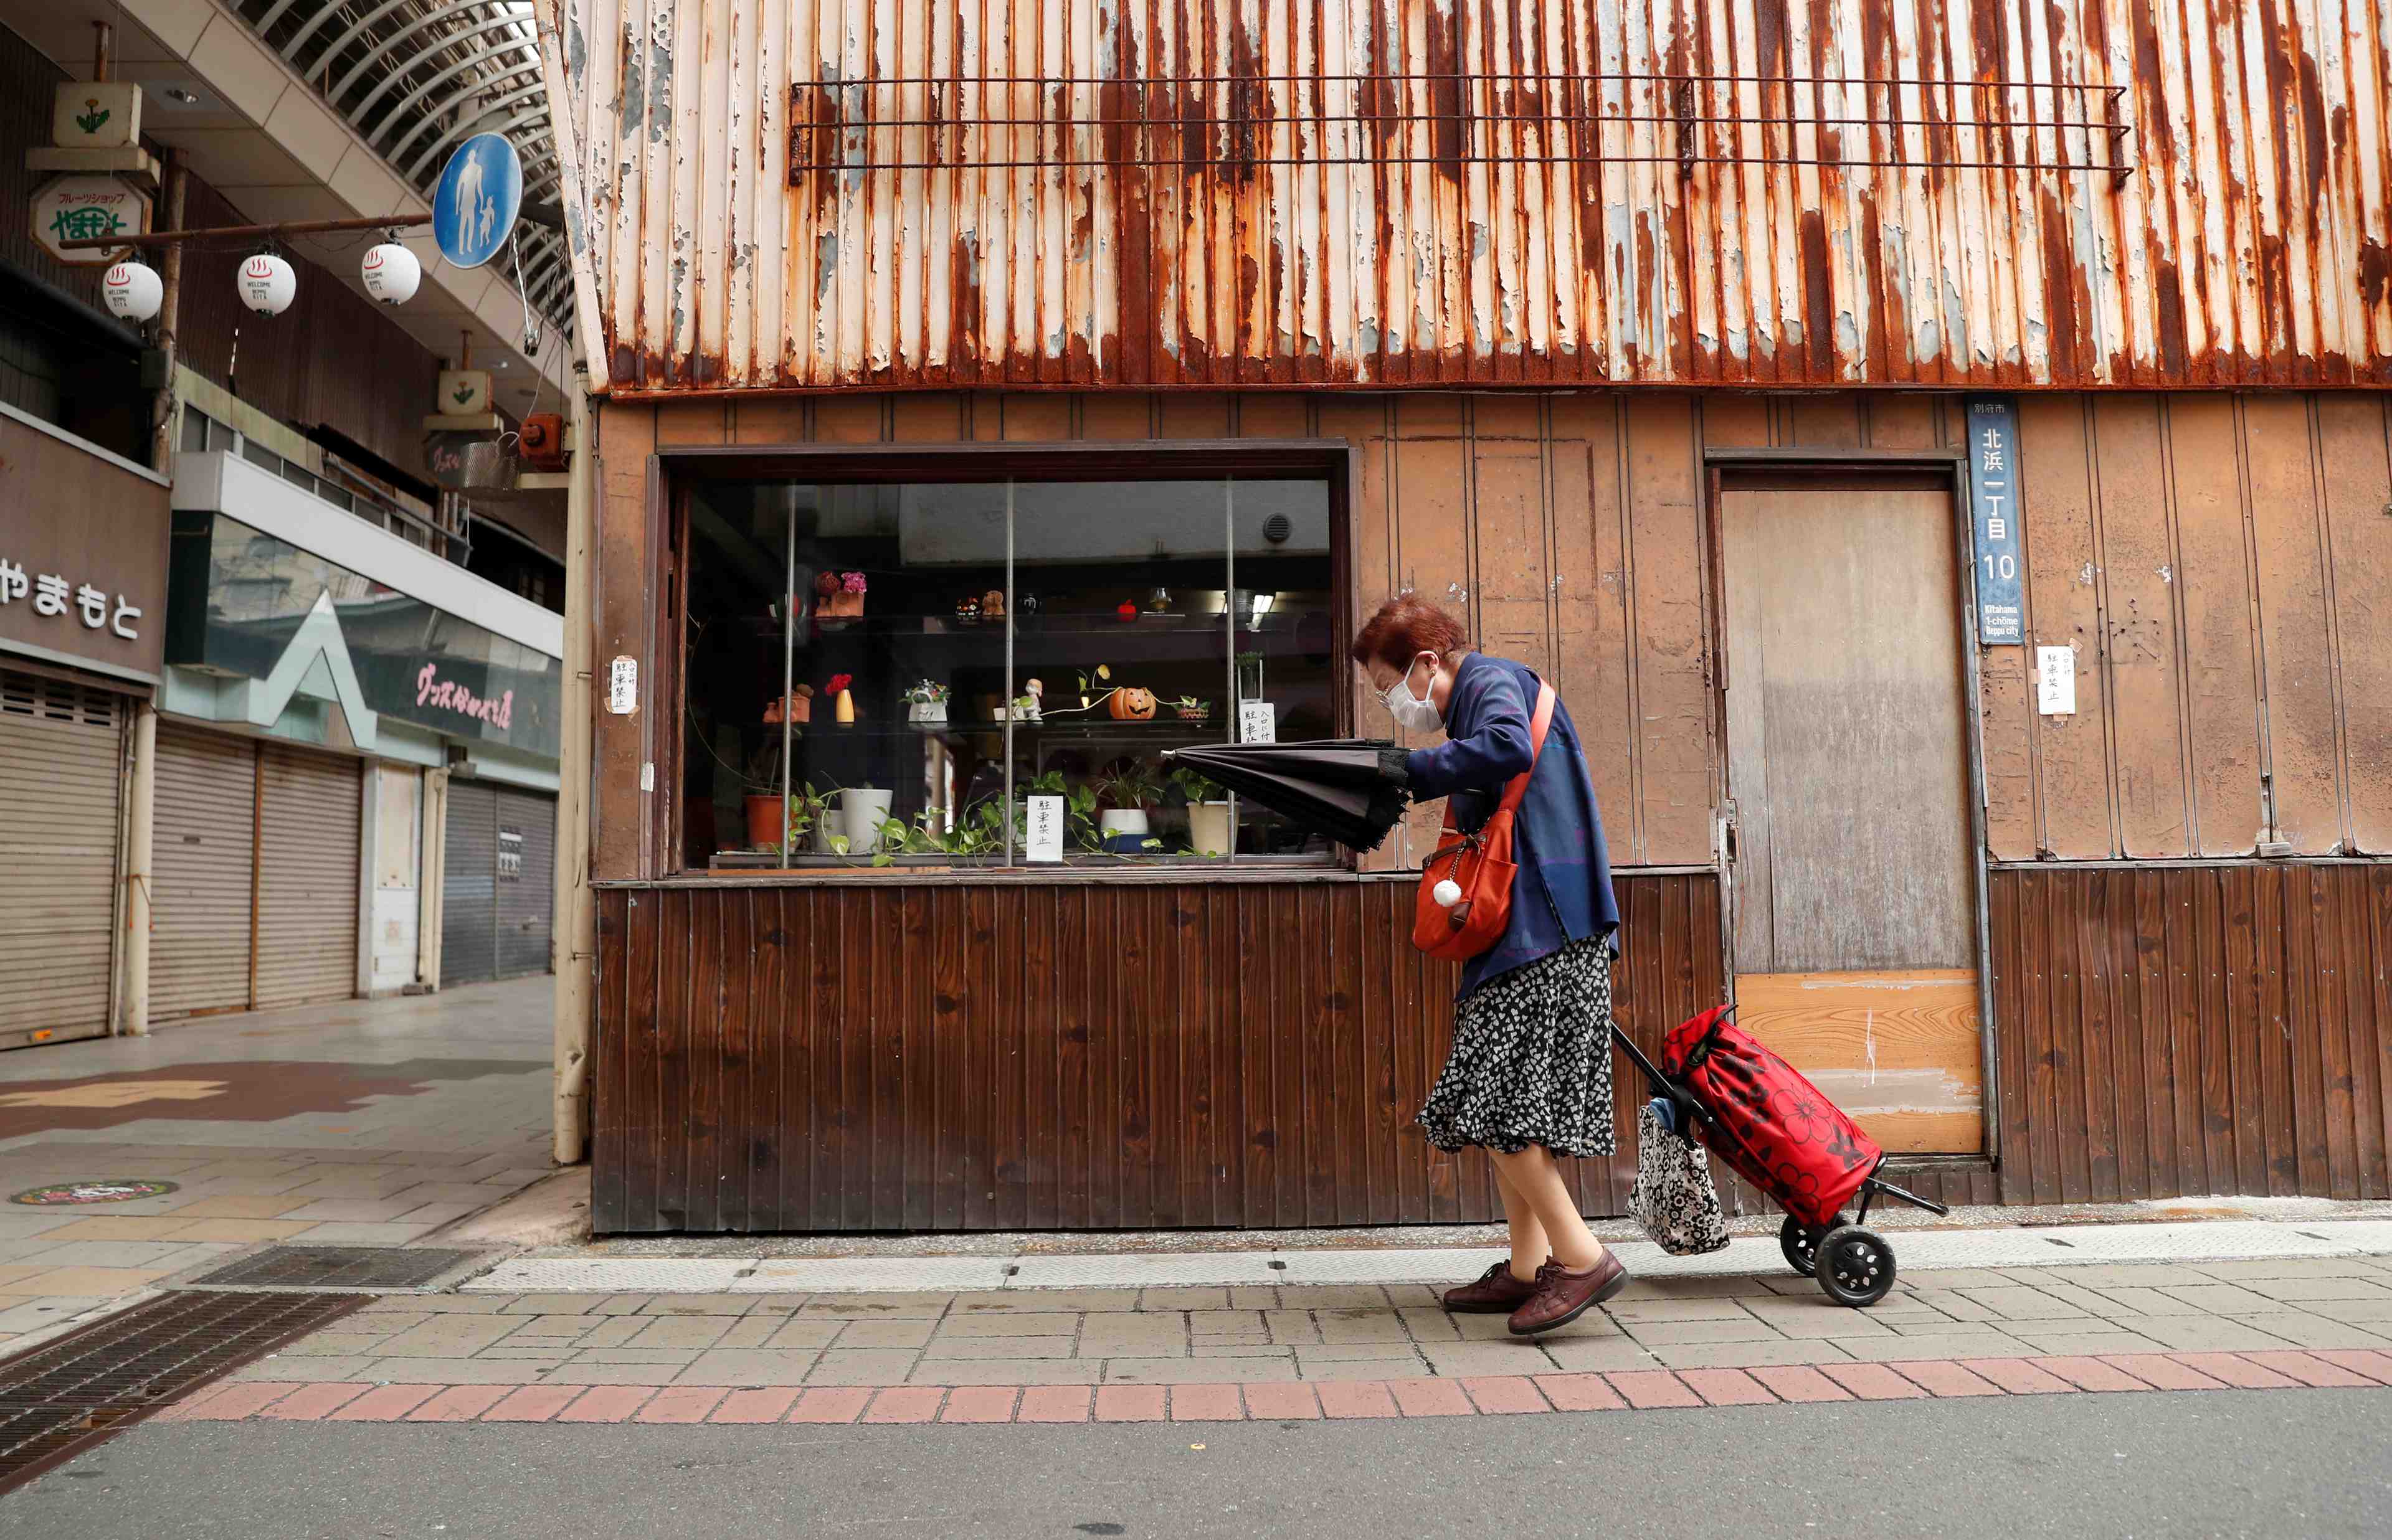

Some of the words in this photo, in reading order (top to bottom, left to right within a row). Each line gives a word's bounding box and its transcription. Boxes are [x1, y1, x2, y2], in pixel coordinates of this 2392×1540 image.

[59, 194, 126, 204] フルーツショップ
[1973, 404, 2005, 414] 別府市
[1983, 428, 2006, 539] 北浜一丁目
[1983, 554, 2015, 580] 10
[1984, 605, 2018, 614] Kitahama
[1985, 616, 2019, 625] 1-chōme
[1986, 627, 2005, 636] Beppu
[2006, 626, 2019, 636] city
[613, 663, 627, 707] 駐車禁止
[2046, 653, 2060, 701] 駐車禁止
[1260, 711, 1271, 741] 入口に付
[1036, 800, 1052, 846] 駐車禁止
